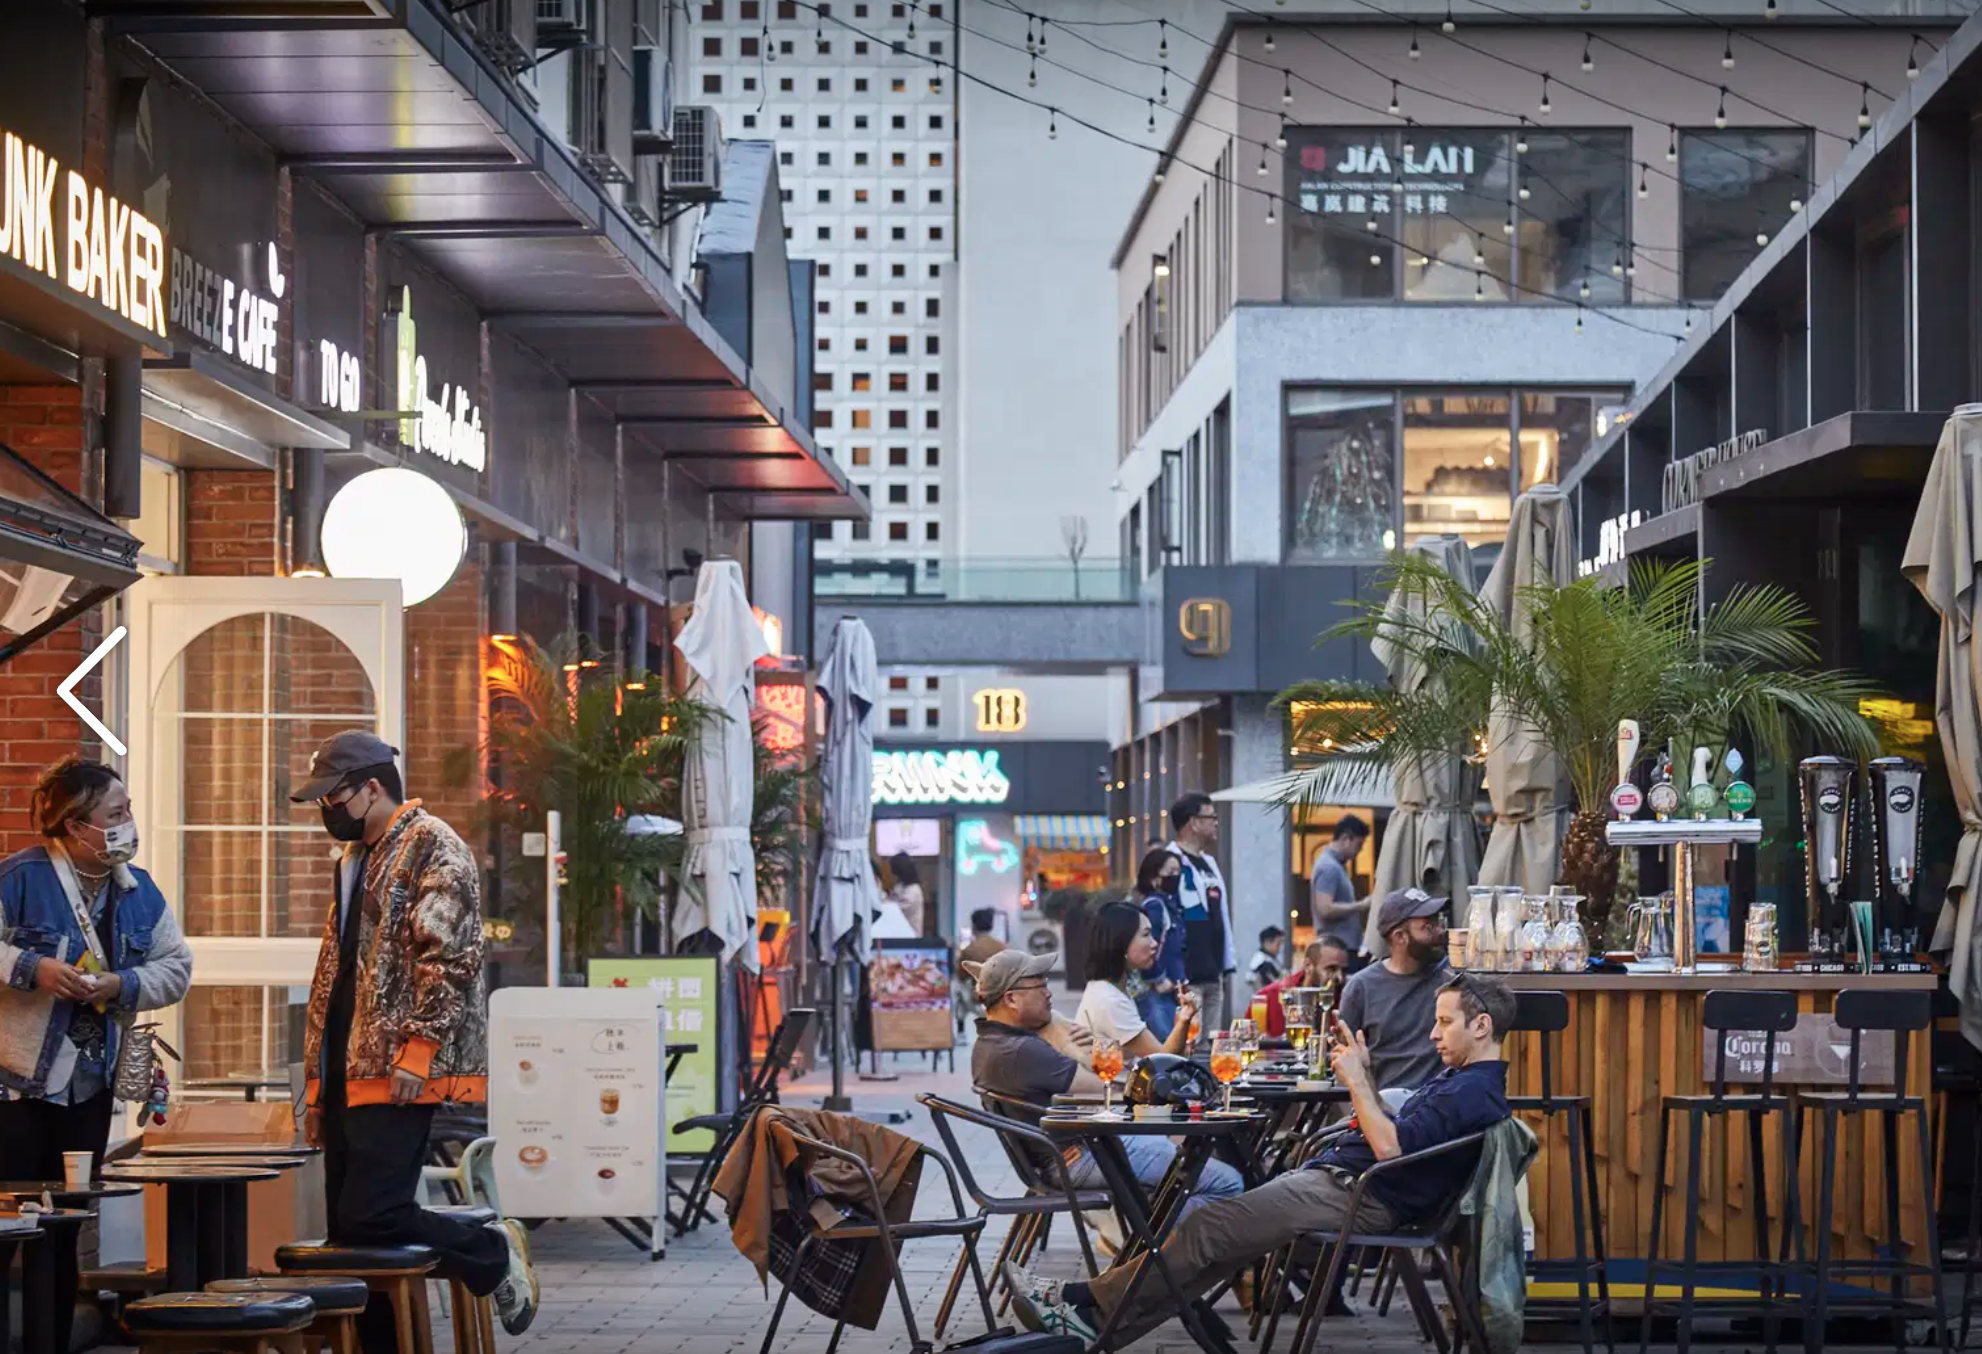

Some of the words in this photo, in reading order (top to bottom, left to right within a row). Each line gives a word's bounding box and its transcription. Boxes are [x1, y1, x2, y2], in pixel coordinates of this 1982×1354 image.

[1337, 144, 1391, 174] JIA
[1403, 144, 1474, 174] LAN
[68, 170, 168, 338] BAKER
[170, 246, 235, 355] BREEZE
[237, 288, 279, 375] CAFE
[320, 338, 339, 408] TO
[340, 350, 360, 412] GO
[972, 688, 1027, 732] 18
